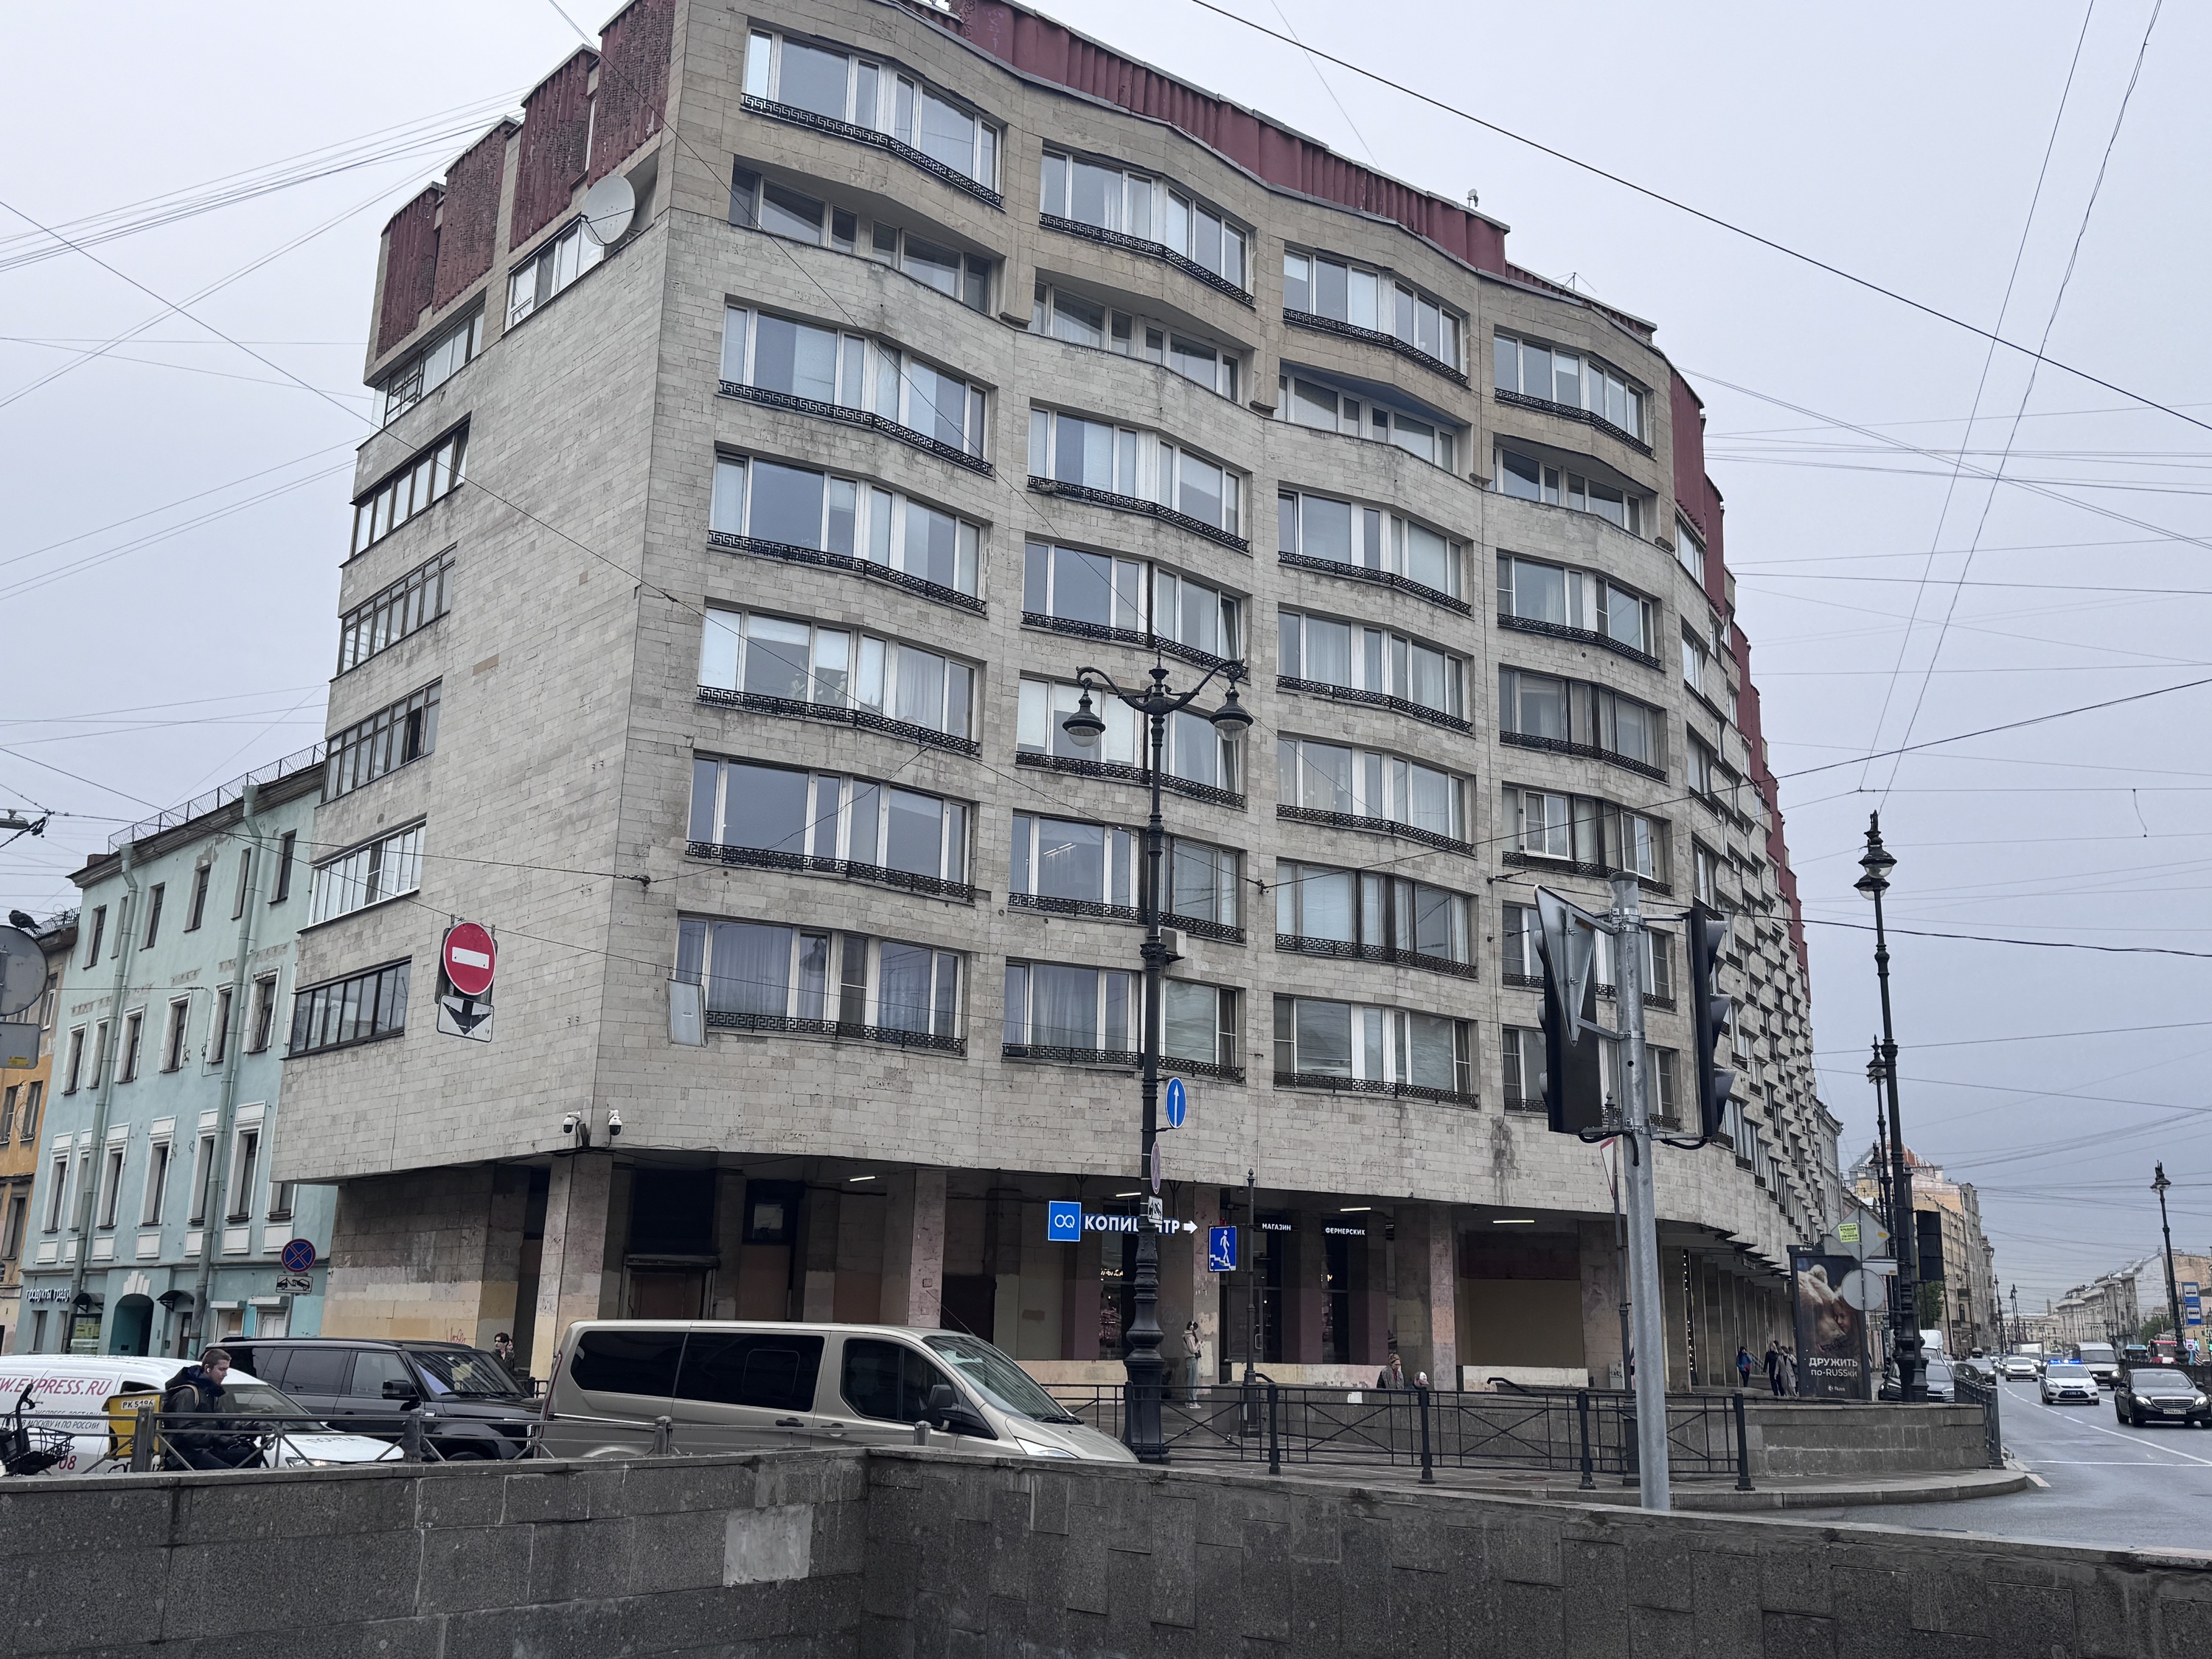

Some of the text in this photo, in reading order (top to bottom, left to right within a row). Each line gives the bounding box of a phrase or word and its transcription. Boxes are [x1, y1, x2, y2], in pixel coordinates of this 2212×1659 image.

[1085, 1215, 1180, 1234] КОПИТР
[1262, 1222, 1291, 1231] МАГАЗИН
[1325, 1228, 1365, 1236] ФЕРМЕРСКИХ
[1809, 1357, 1858, 1367] ДРУЖИТЬ
[27, 1419, 55, 1428] МОСКВУ
[61, 1421, 72, 1429] ПО
[72, 1422, 100, 1430] РОССИИ
